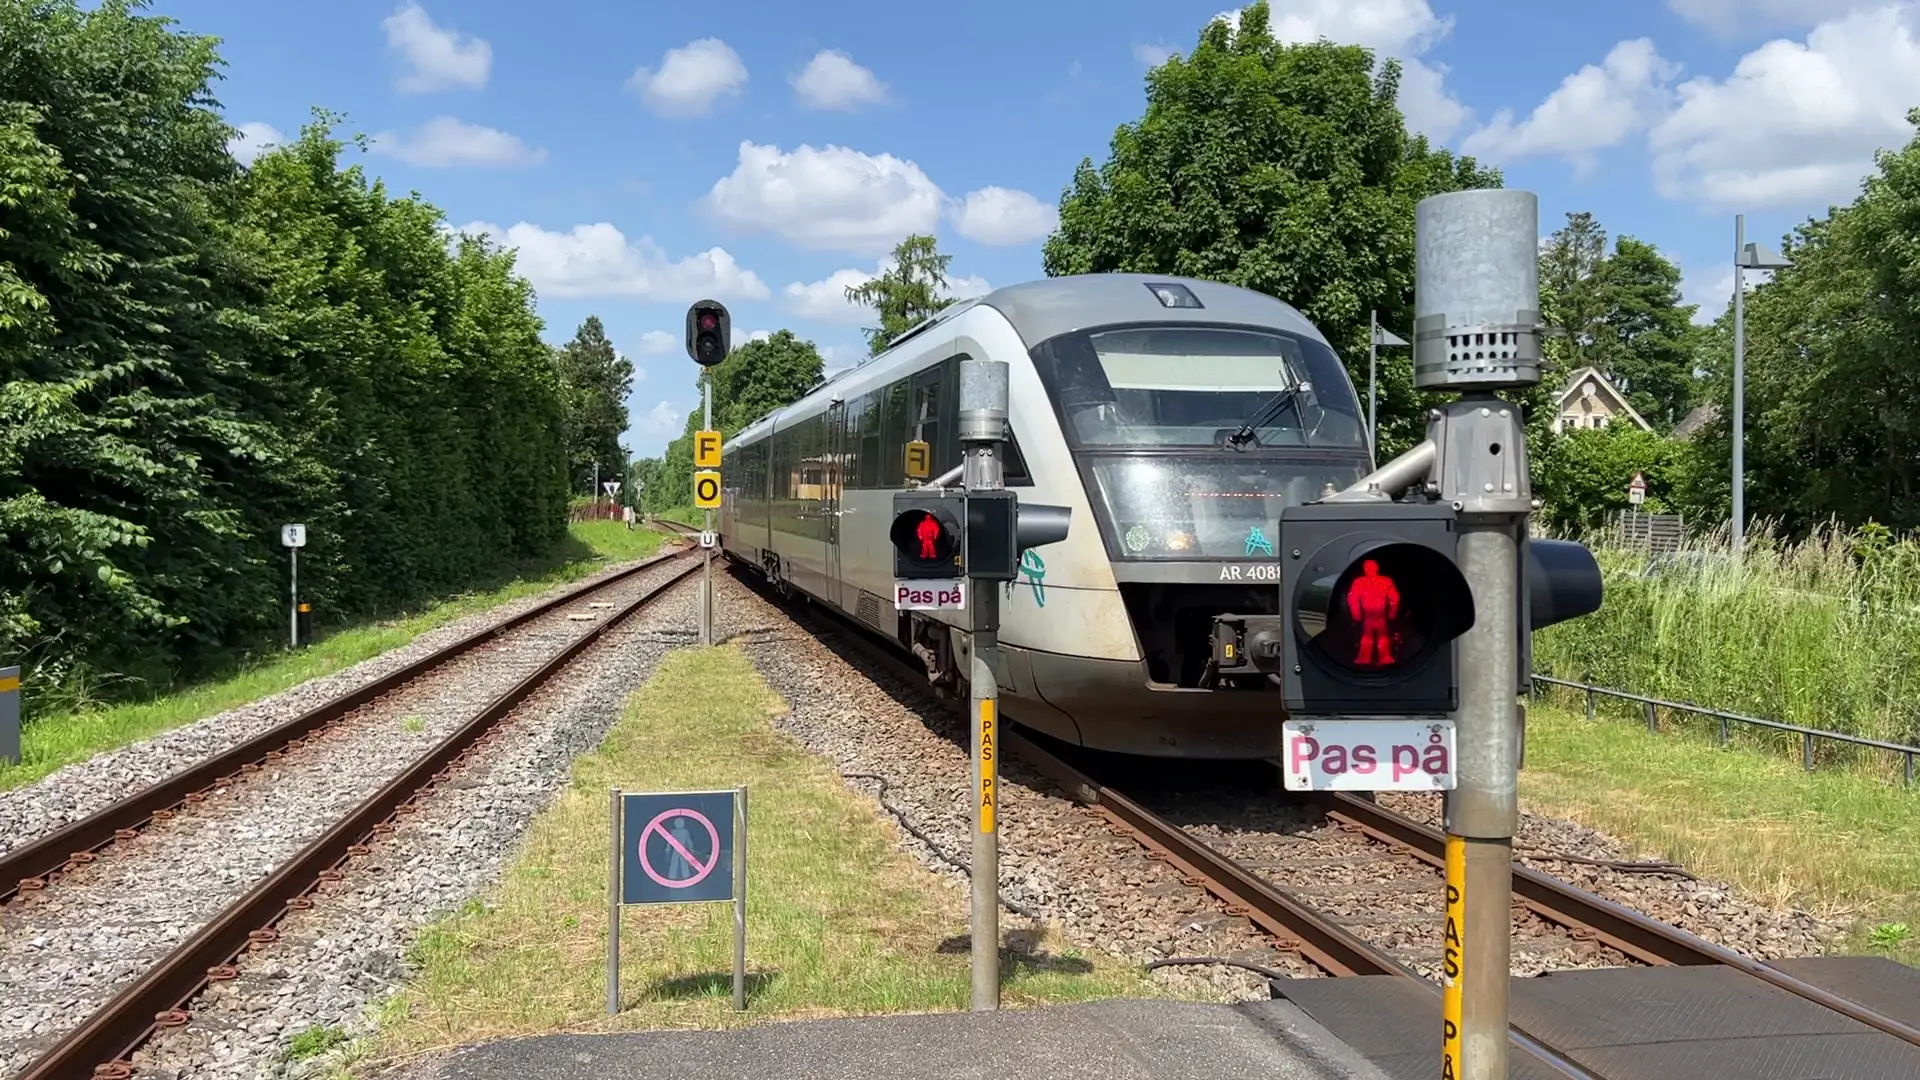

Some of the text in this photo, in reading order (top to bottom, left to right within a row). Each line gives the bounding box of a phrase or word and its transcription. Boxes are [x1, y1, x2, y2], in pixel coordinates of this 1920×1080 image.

[700, 438, 716, 460] F
[703, 534, 713, 545] U
[1220, 565, 1242, 581] AR
[898, 586, 961, 607] Pas på
[982, 720, 992, 807] PAS PÅ
[1291, 733, 1449, 782] Pas på
[1445, 884, 1460, 978] PAS
